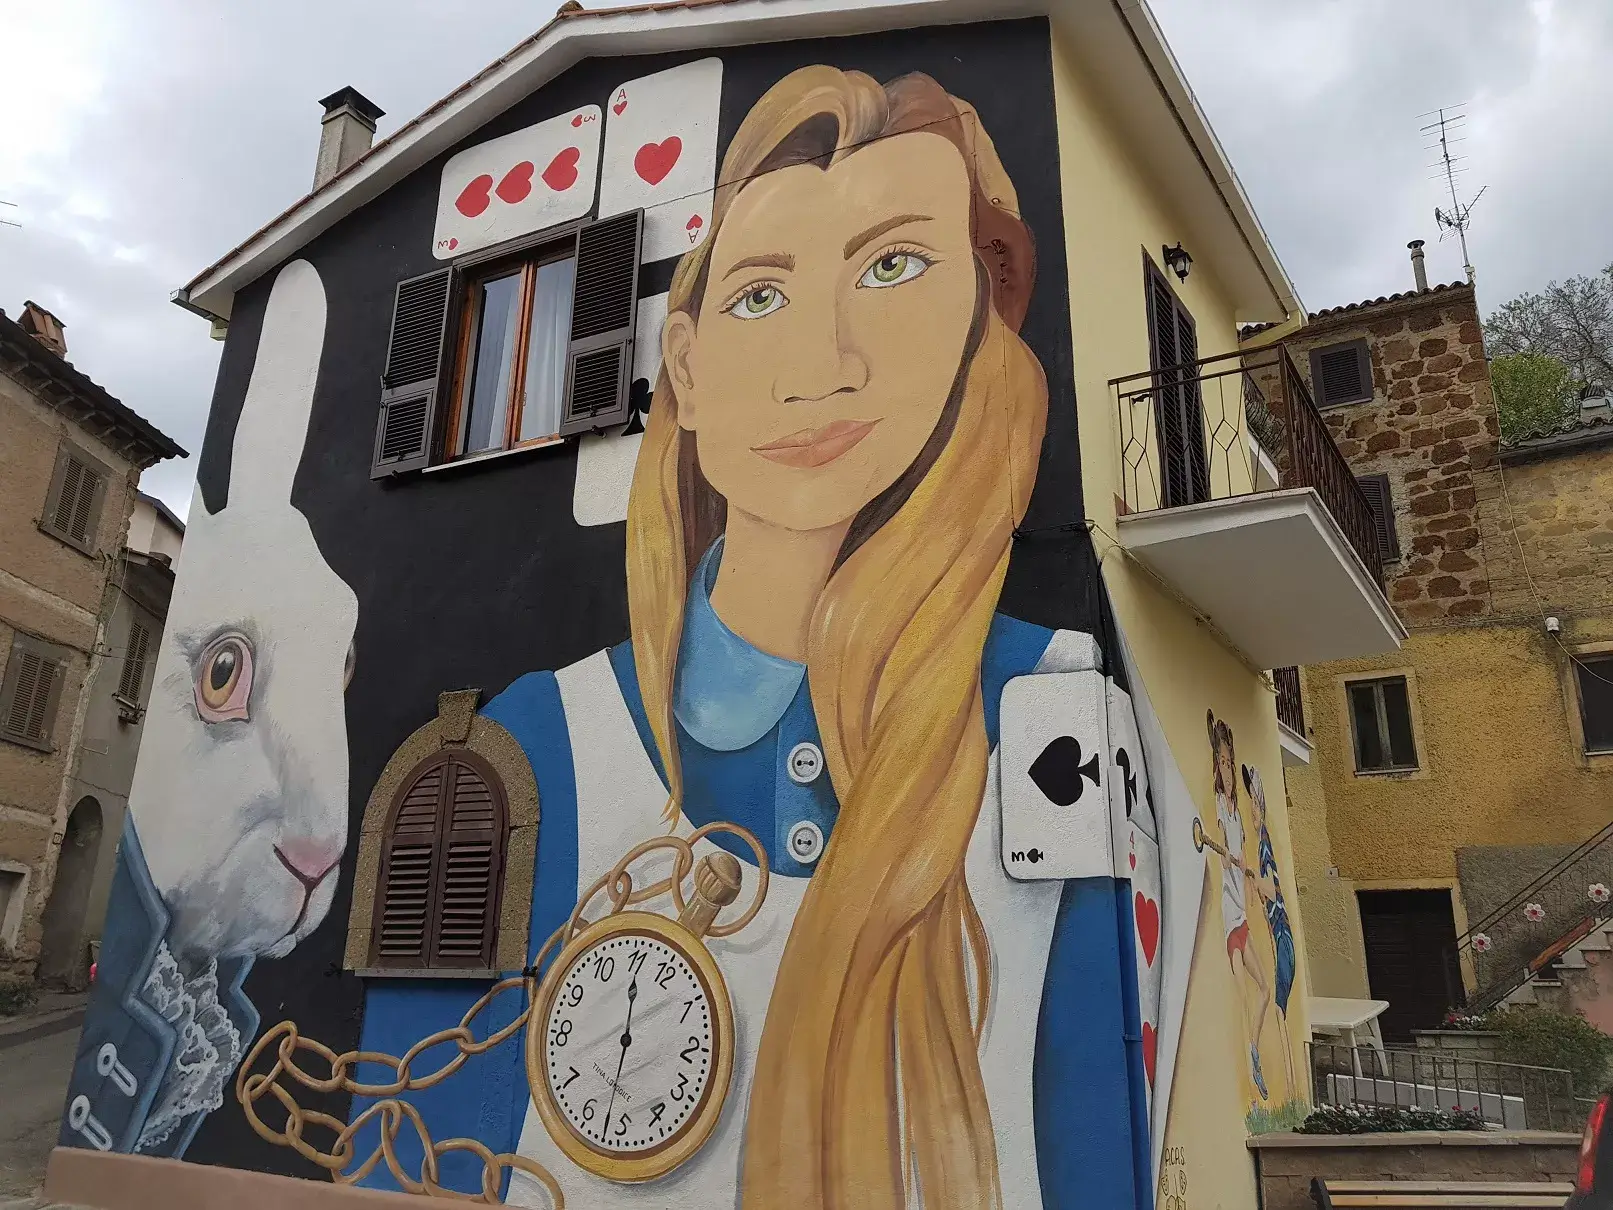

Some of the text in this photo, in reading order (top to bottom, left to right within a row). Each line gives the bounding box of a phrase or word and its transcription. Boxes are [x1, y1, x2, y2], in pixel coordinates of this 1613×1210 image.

[616, 88, 628, 102] A
[583, 113, 597, 124] 3
[437, 240, 449, 249] 3
[687, 230, 699, 244] A
[1011, 851, 1025, 862] 3
[593, 956, 615, 982] 10
[627, 950, 648, 975] 11
[654, 962, 677, 990] 12
[568, 985, 583, 1006] 9
[680, 1001, 694, 1024] 1
[556, 1020, 572, 1046] 8
[679, 1036, 700, 1064] 2
[562, 1067, 580, 1089] 7
[592, 1061, 606, 1080] TINA
[670, 1072, 689, 1101] 3
[582, 1099, 597, 1120] 6
[648, 1102, 666, 1128] 4
[614, 1113, 633, 1136] 5
